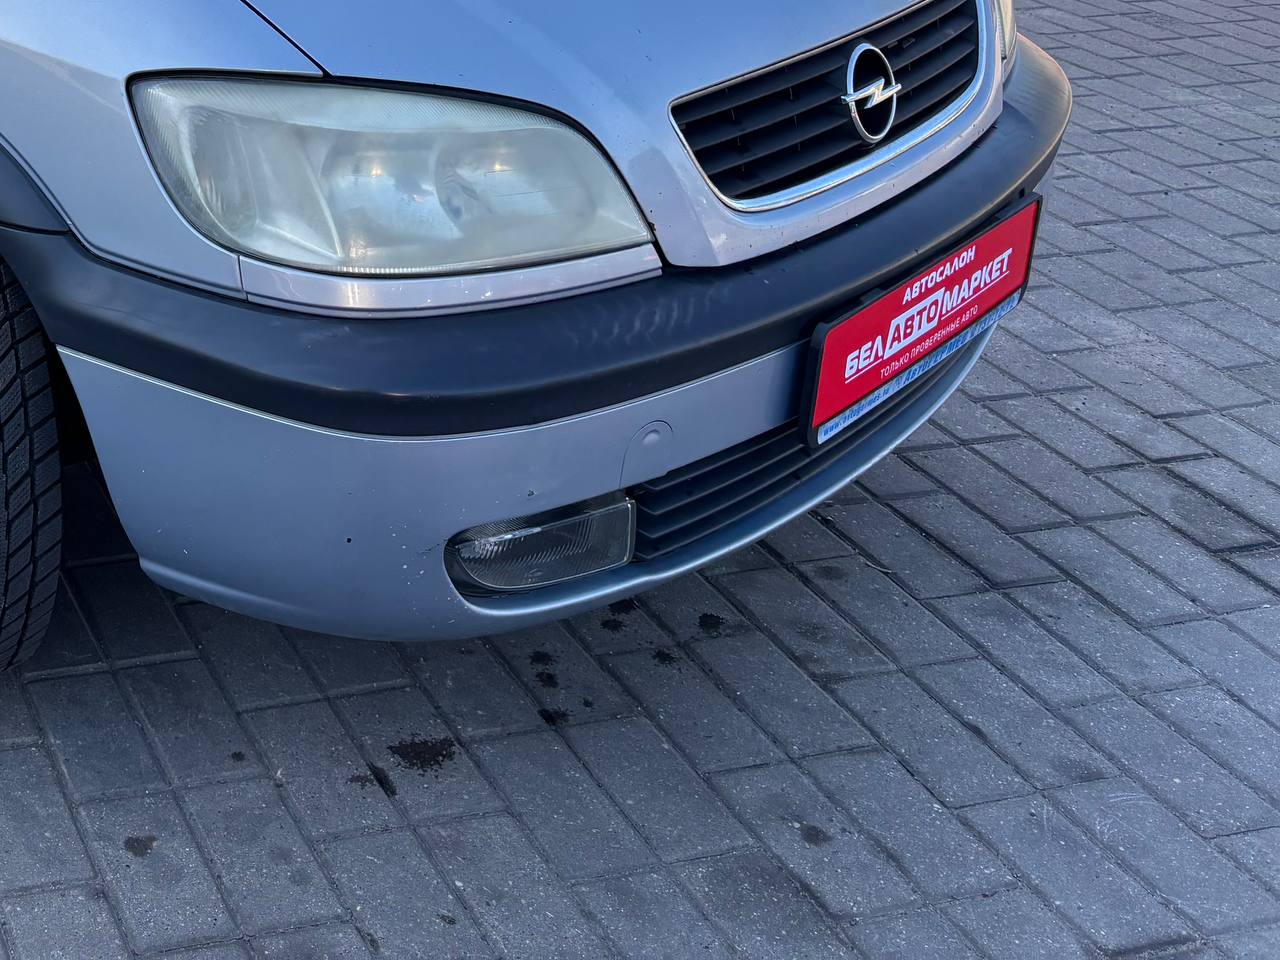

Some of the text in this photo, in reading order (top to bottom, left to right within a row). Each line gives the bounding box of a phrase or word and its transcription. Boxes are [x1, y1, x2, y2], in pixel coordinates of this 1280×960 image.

[902, 245, 977, 305] АВТОСАЛОН
[880, 352, 910, 379] ТОЛЬКО
[910, 318, 961, 360] ПРОВЕРЕННЫЕ
[960, 304, 979, 326] АВТО
